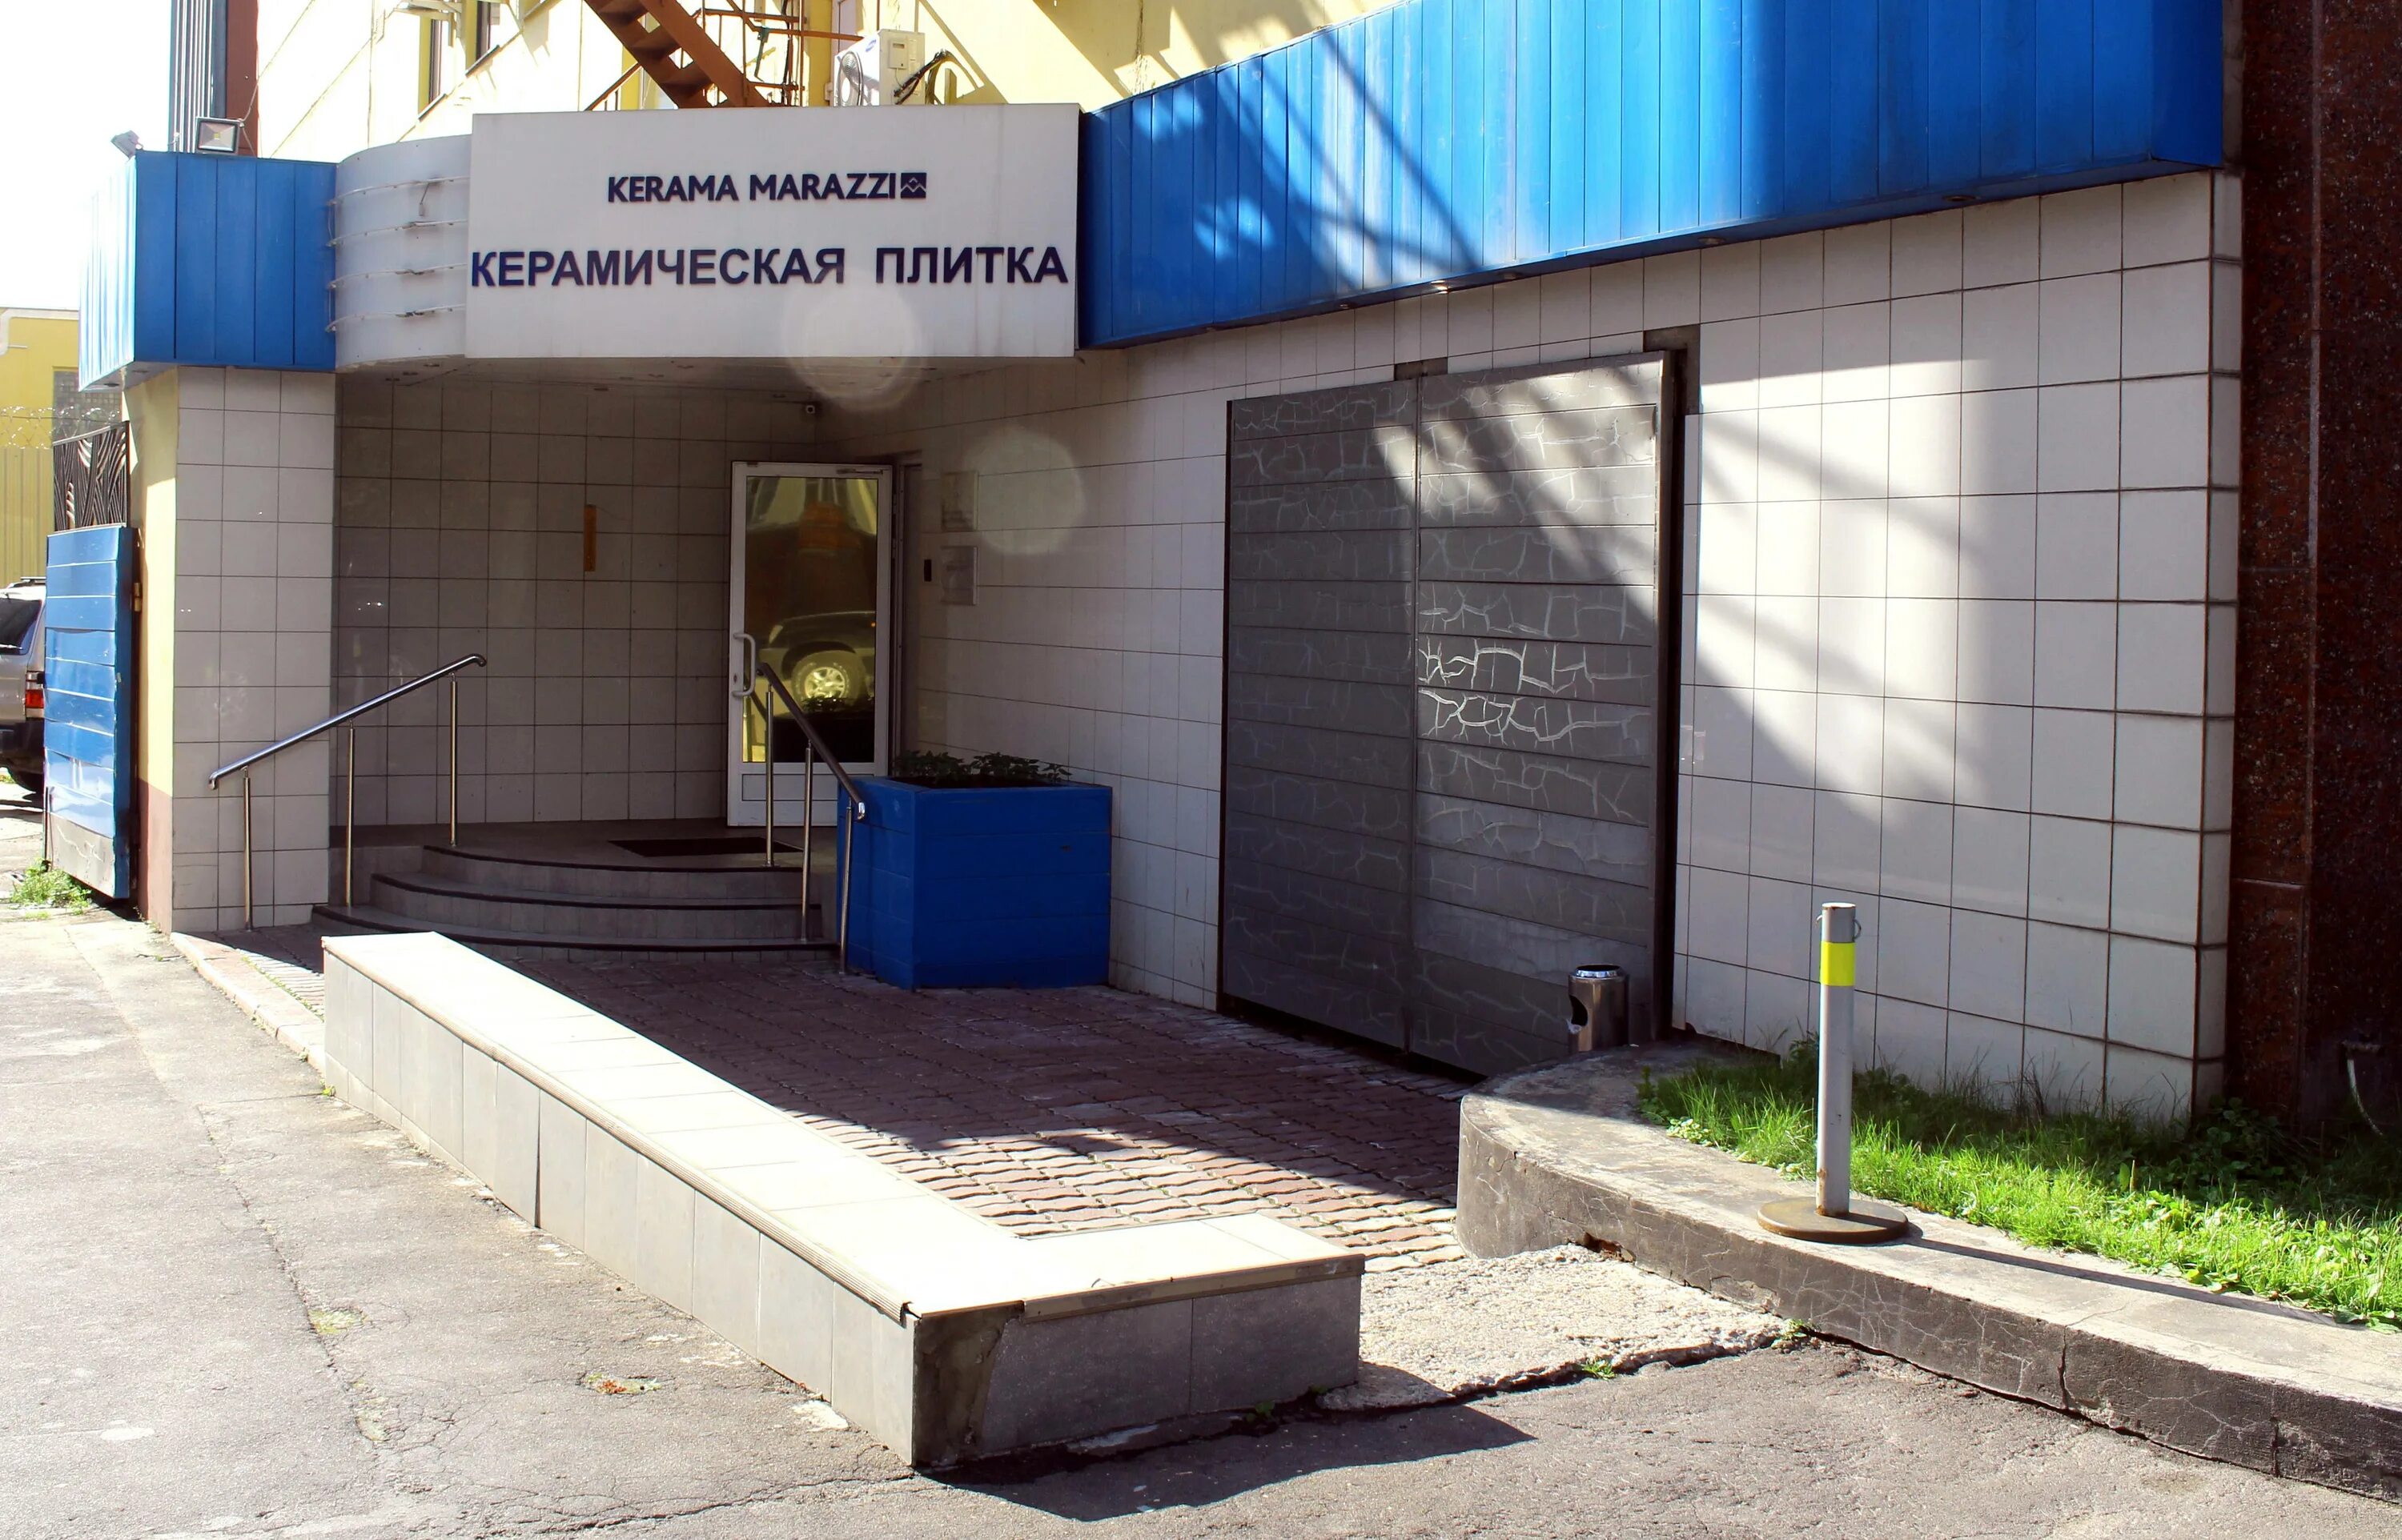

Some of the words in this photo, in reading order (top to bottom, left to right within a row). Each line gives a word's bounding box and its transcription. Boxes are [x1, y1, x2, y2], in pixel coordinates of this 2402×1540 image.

[608, 174, 740, 203] KERAMA
[749, 172, 897, 202] MARAZZI
[472, 247, 846, 287] КЕРАМИЧЕСКАЯ
[875, 247, 1069, 284] ПЛИТКА
